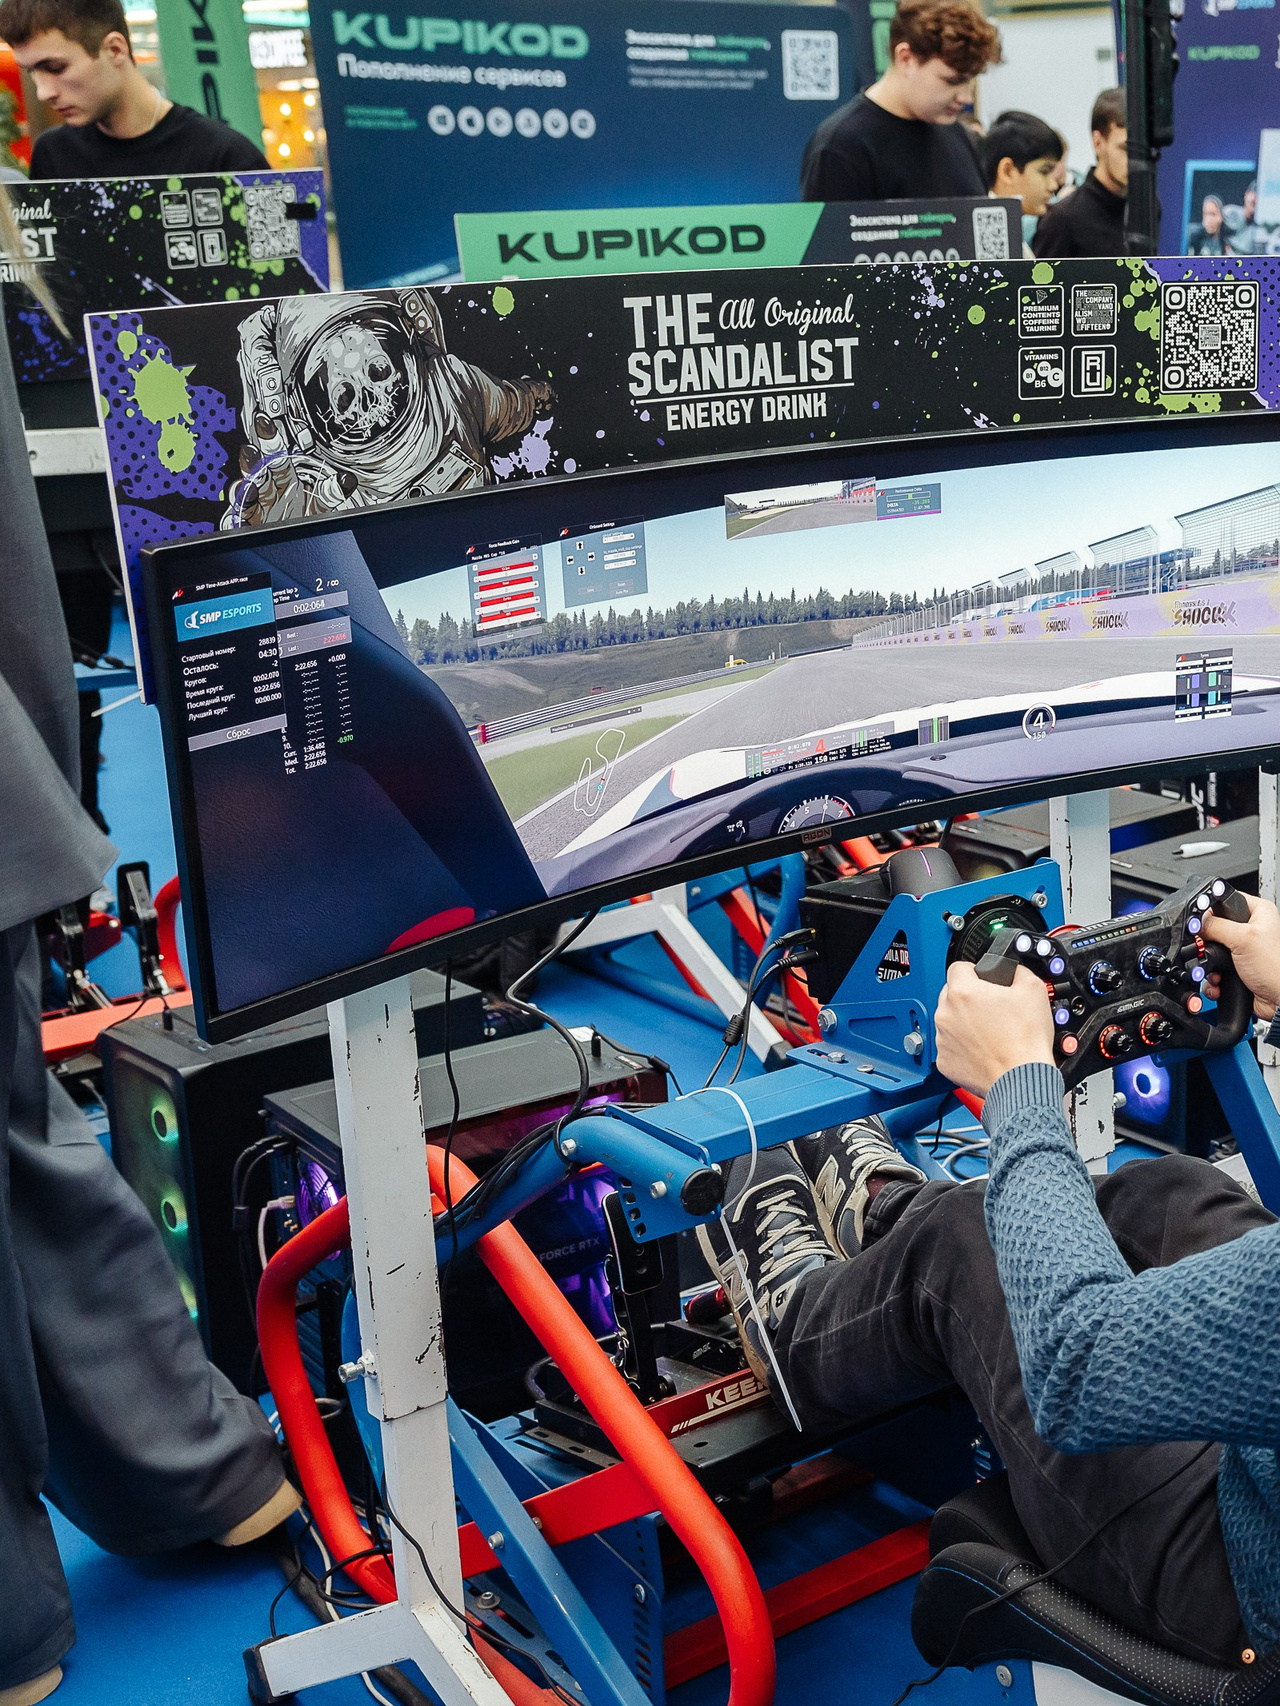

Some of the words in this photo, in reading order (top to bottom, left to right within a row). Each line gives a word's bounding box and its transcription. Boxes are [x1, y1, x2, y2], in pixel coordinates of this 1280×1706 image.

[332, 9, 590, 58] KUPIKOD
[337, 52, 471, 84] Пополнение
[474, 66, 567, 90] сервисов
[497, 223, 767, 264] KUPIKOD
[1021, 311, 1061, 319] CONTENTS
[1023, 304, 1059, 312] PREMIUM
[623, 292, 715, 349] THE
[718, 299, 756, 331] All
[764, 293, 855, 335] Original
[1022, 318, 1060, 326] COFFEINE
[1024, 353, 1059, 361] VITAMINS
[627, 337, 860, 397] SCANDALIST
[1034, 379, 1047, 388] B6
[666, 398, 754, 431] ENERGY
[761, 392, 828, 423] DRINK
[315, 577, 324, 592] 2
[200, 610, 222, 625] SMP
[222, 603, 262, 620] ESPORTS
[181, 650, 214, 663] Стартовый
[215, 646, 236, 656] номер:
[258, 648, 277, 659] 04:30
[183, 662, 219, 676] Осталось:
[294, 660, 318, 671] 2:22.656
[328, 653, 346, 663] +0.000
[184, 677, 207, 688] Кругов:
[253, 681, 281, 694] 02:22.656
[185, 688, 205, 699] Время
[206, 685, 224, 694] круга:
[254, 692, 282, 705] 00:00.000
[187, 696, 220, 710] Последний
[221, 693, 236, 703] круг:
[188, 709, 213, 721] Лучший
[213, 706, 229, 716] круг:
[1033, 711, 1046, 729] 4
[226, 728, 251, 740] Сброс
[814, 738, 826, 755] 4
[284, 758, 299, 767] Med.
[304, 750, 327, 762] 2:22.656
[304, 758, 327, 770] 2:22.656
[814, 755, 828, 764] 150
[803, 828, 831, 843] AGON
[1116, 999, 1145, 1014] SIMAGIC
[578, 1236, 600, 1251] RTX
[705, 1376, 765, 1410] KEE
